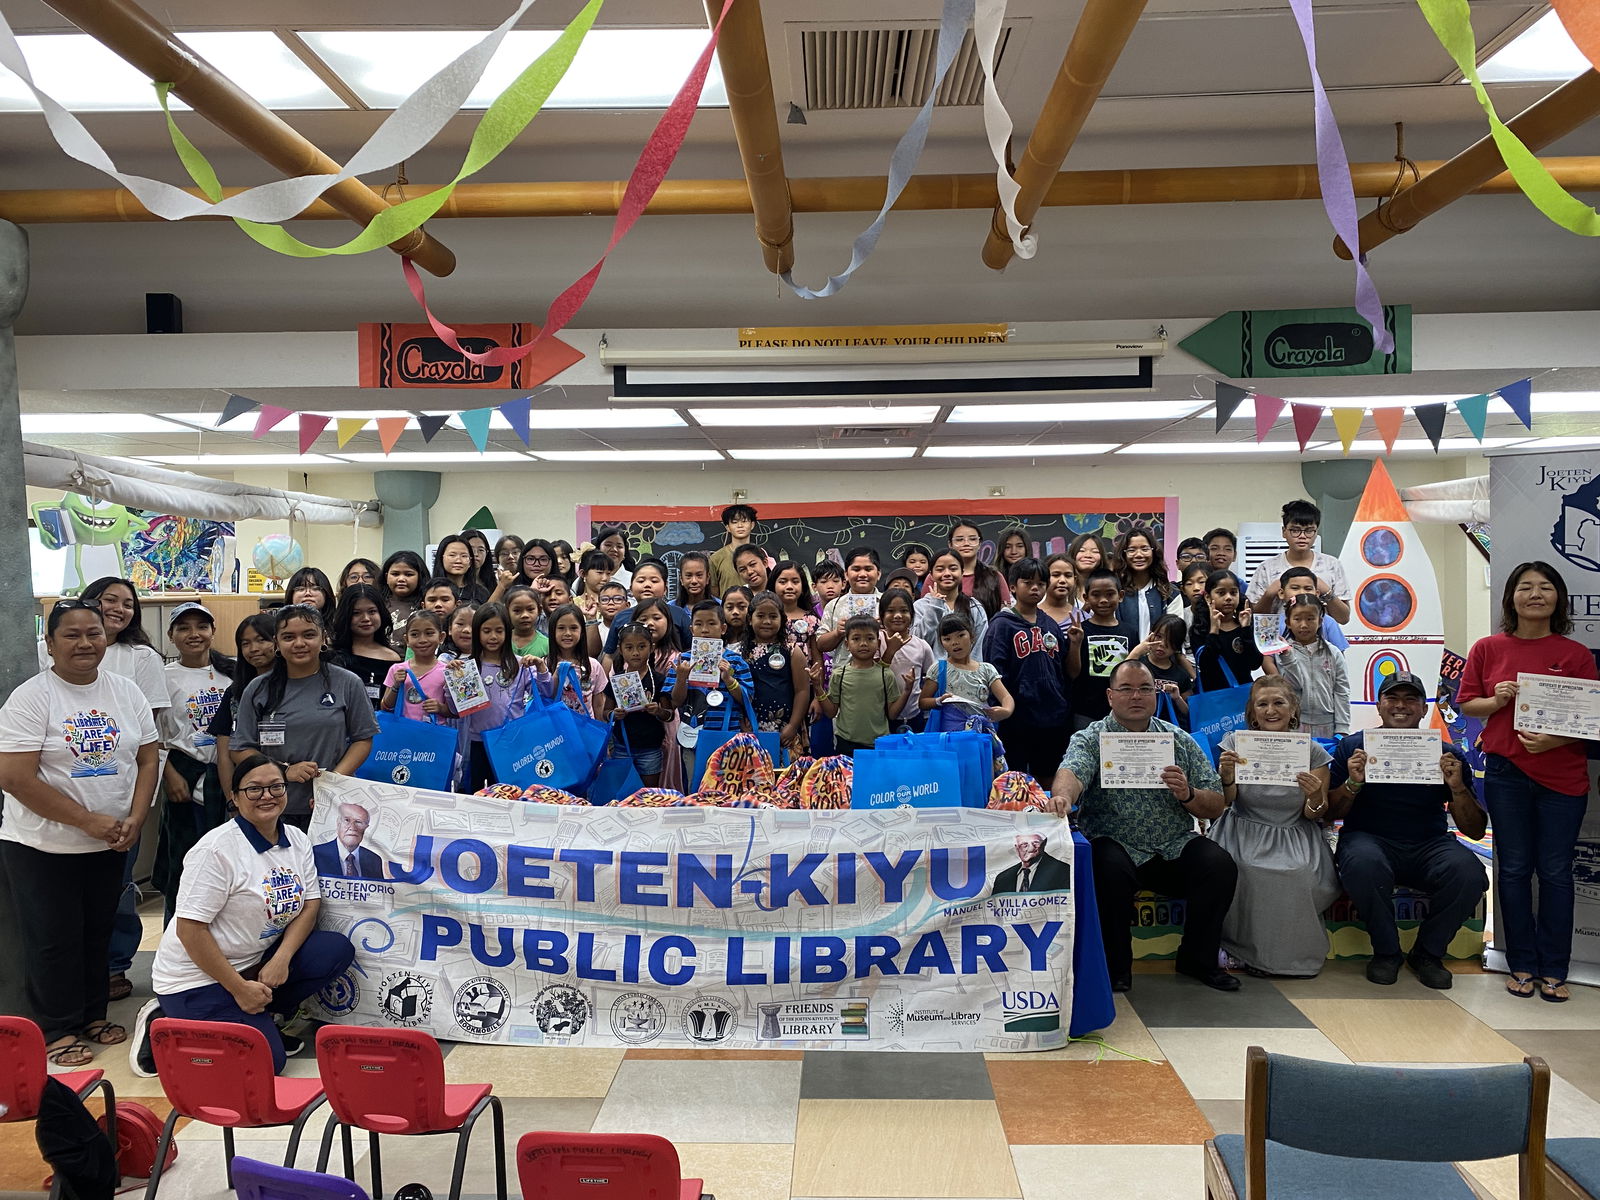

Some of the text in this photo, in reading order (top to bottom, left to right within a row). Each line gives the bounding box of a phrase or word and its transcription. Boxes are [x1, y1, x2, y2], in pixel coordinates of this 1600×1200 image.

[739, 339, 787, 348] PLEASE
[792, 338, 811, 347] DO
[814, 338, 843, 347] NOT
[894, 336, 930, 345] YOUR
[934, 335, 1006, 345] CHILDREN
[1270, 336, 1345, 364] Crayola
[403, 344, 485, 380] Crayola
[1536, 466, 1592, 486] JOETEN
[1550, 477, 1592, 491] KIYU
[1093, 645, 1120, 662] NIKE
[73, 717, 107, 728] LIBRARIES
[84, 729, 103, 740] ARE
[375, 750, 398, 761] COLOR
[412, 751, 436, 763] WORLD
[512, 753, 535, 773] COLOREA
[544, 734, 564, 752] MUNDO
[870, 790, 895, 806] COLOR
[912, 781, 939, 798] WORLD
[276, 888, 293, 901] ARE
[319, 879, 395, 895] SE C. TENORIO
[321, 889, 371, 902] "JOETEN"
[943, 896, 1068, 917] MANUEL S. VILLAGOMEZ
[990, 908, 1021, 917] "KIYU"
[1574, 928, 1600, 937] Museu
[419, 914, 1064, 986] PUBLIC LIBRARY
[1001, 991, 1060, 1010] USDA
[403, 1001, 434, 1028] LIBRARY
[785, 1003, 834, 1014] FRIENDS
[906, 1012, 943, 1022] Museum
[951, 1011, 981, 1022] Library
[459, 1017, 501, 1034] BOOKMOBILE
[782, 1023, 835, 1035] LIBRARY
